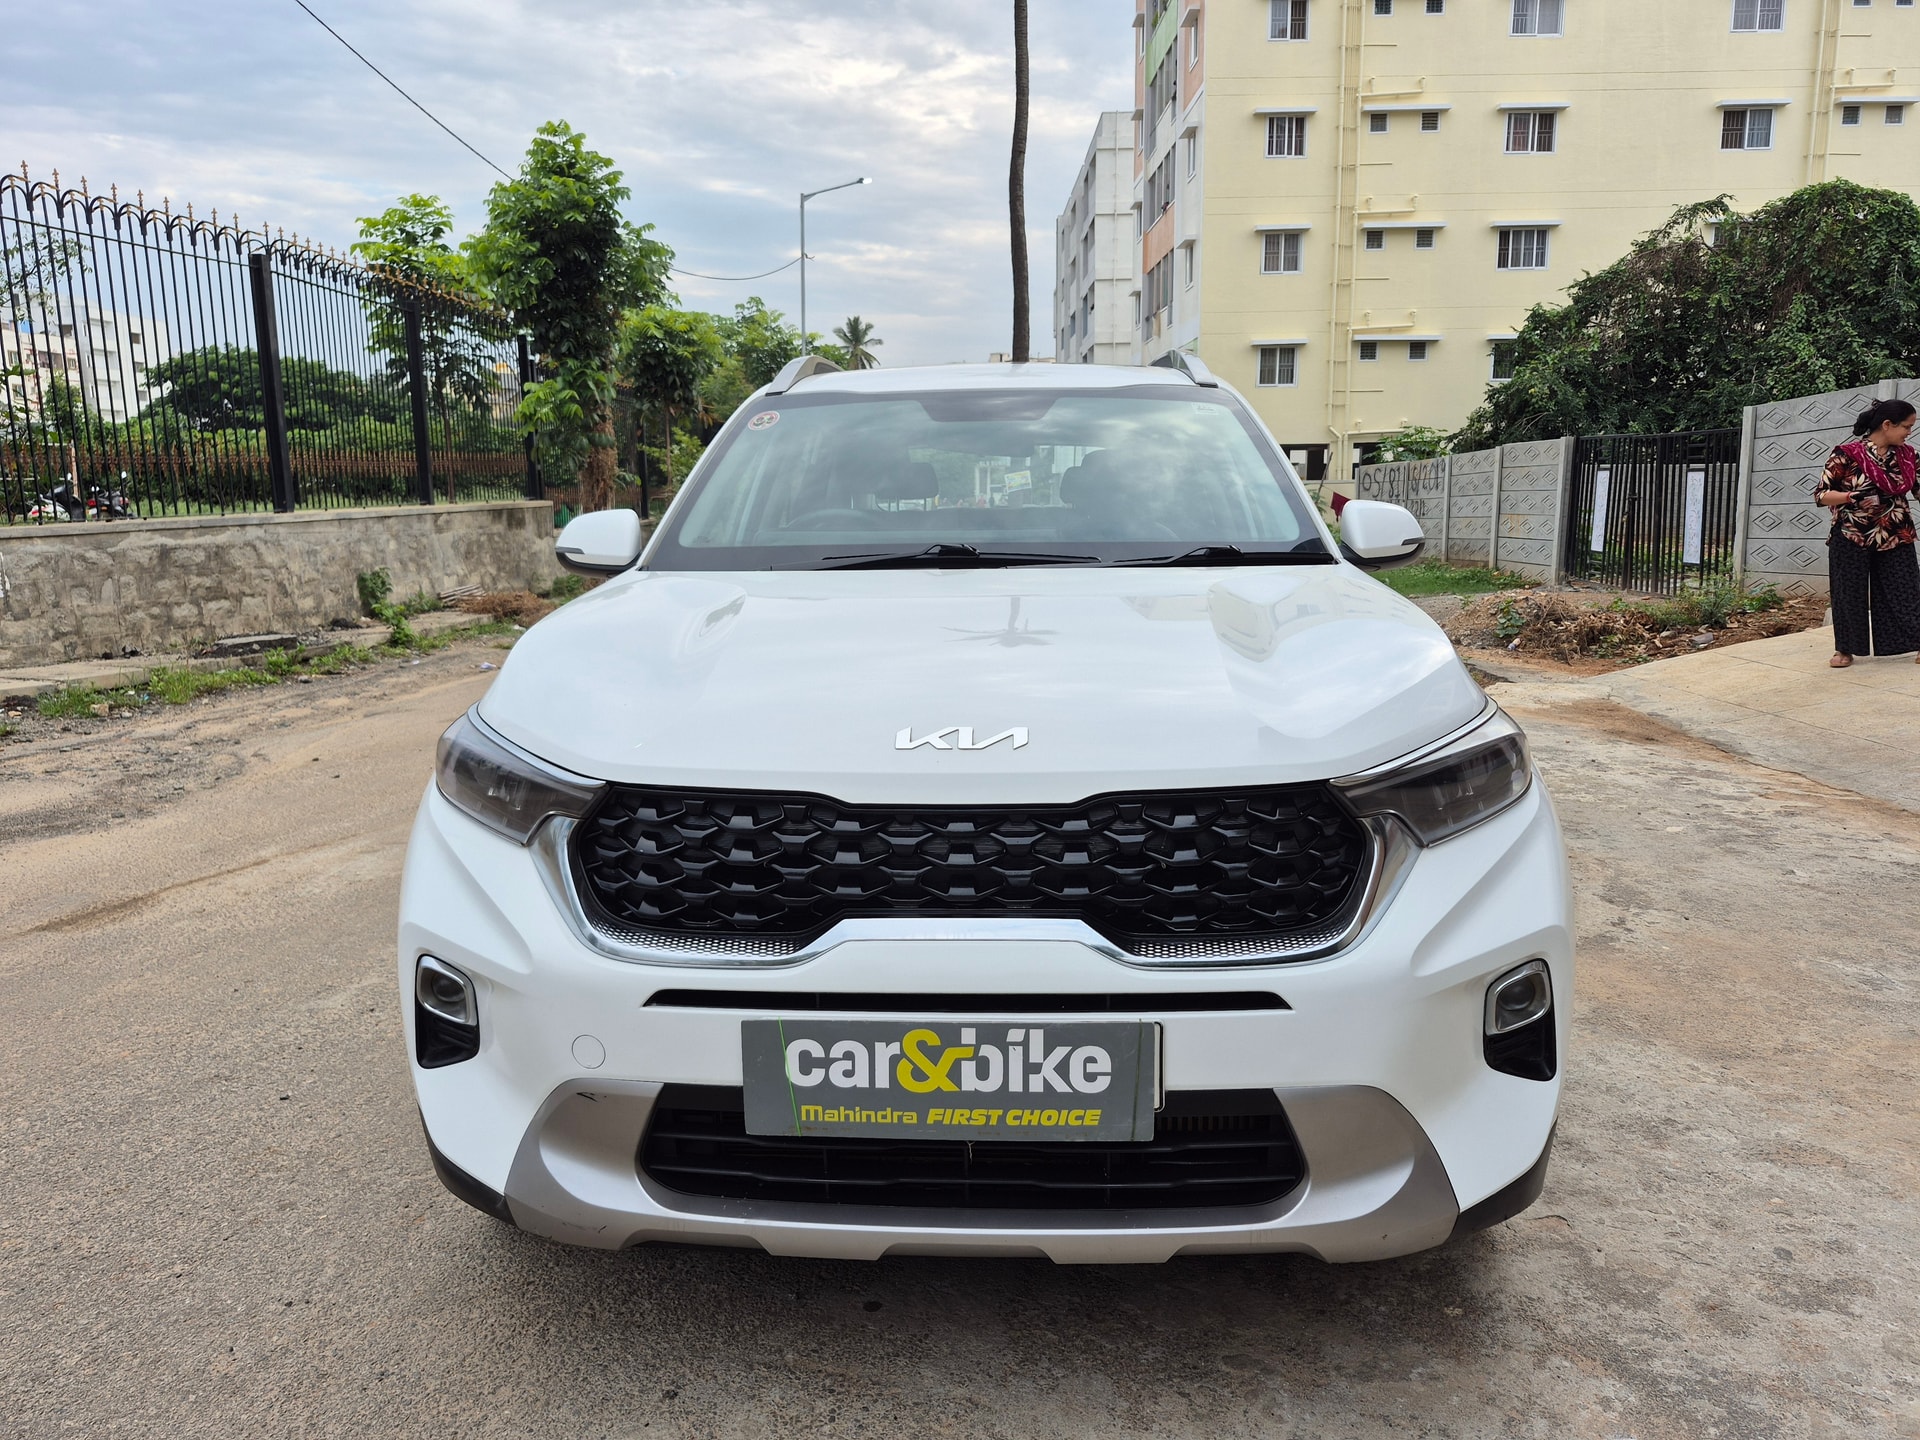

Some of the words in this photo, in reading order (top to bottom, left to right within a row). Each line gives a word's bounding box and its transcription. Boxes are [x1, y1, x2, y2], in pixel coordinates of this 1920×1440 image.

[786, 1028, 1112, 1093] car&bike
[801, 1105, 917, 1124] Mahindra
[926, 1108, 1003, 1126] FIRST
[1005, 1109, 1102, 1126] CHOICE
